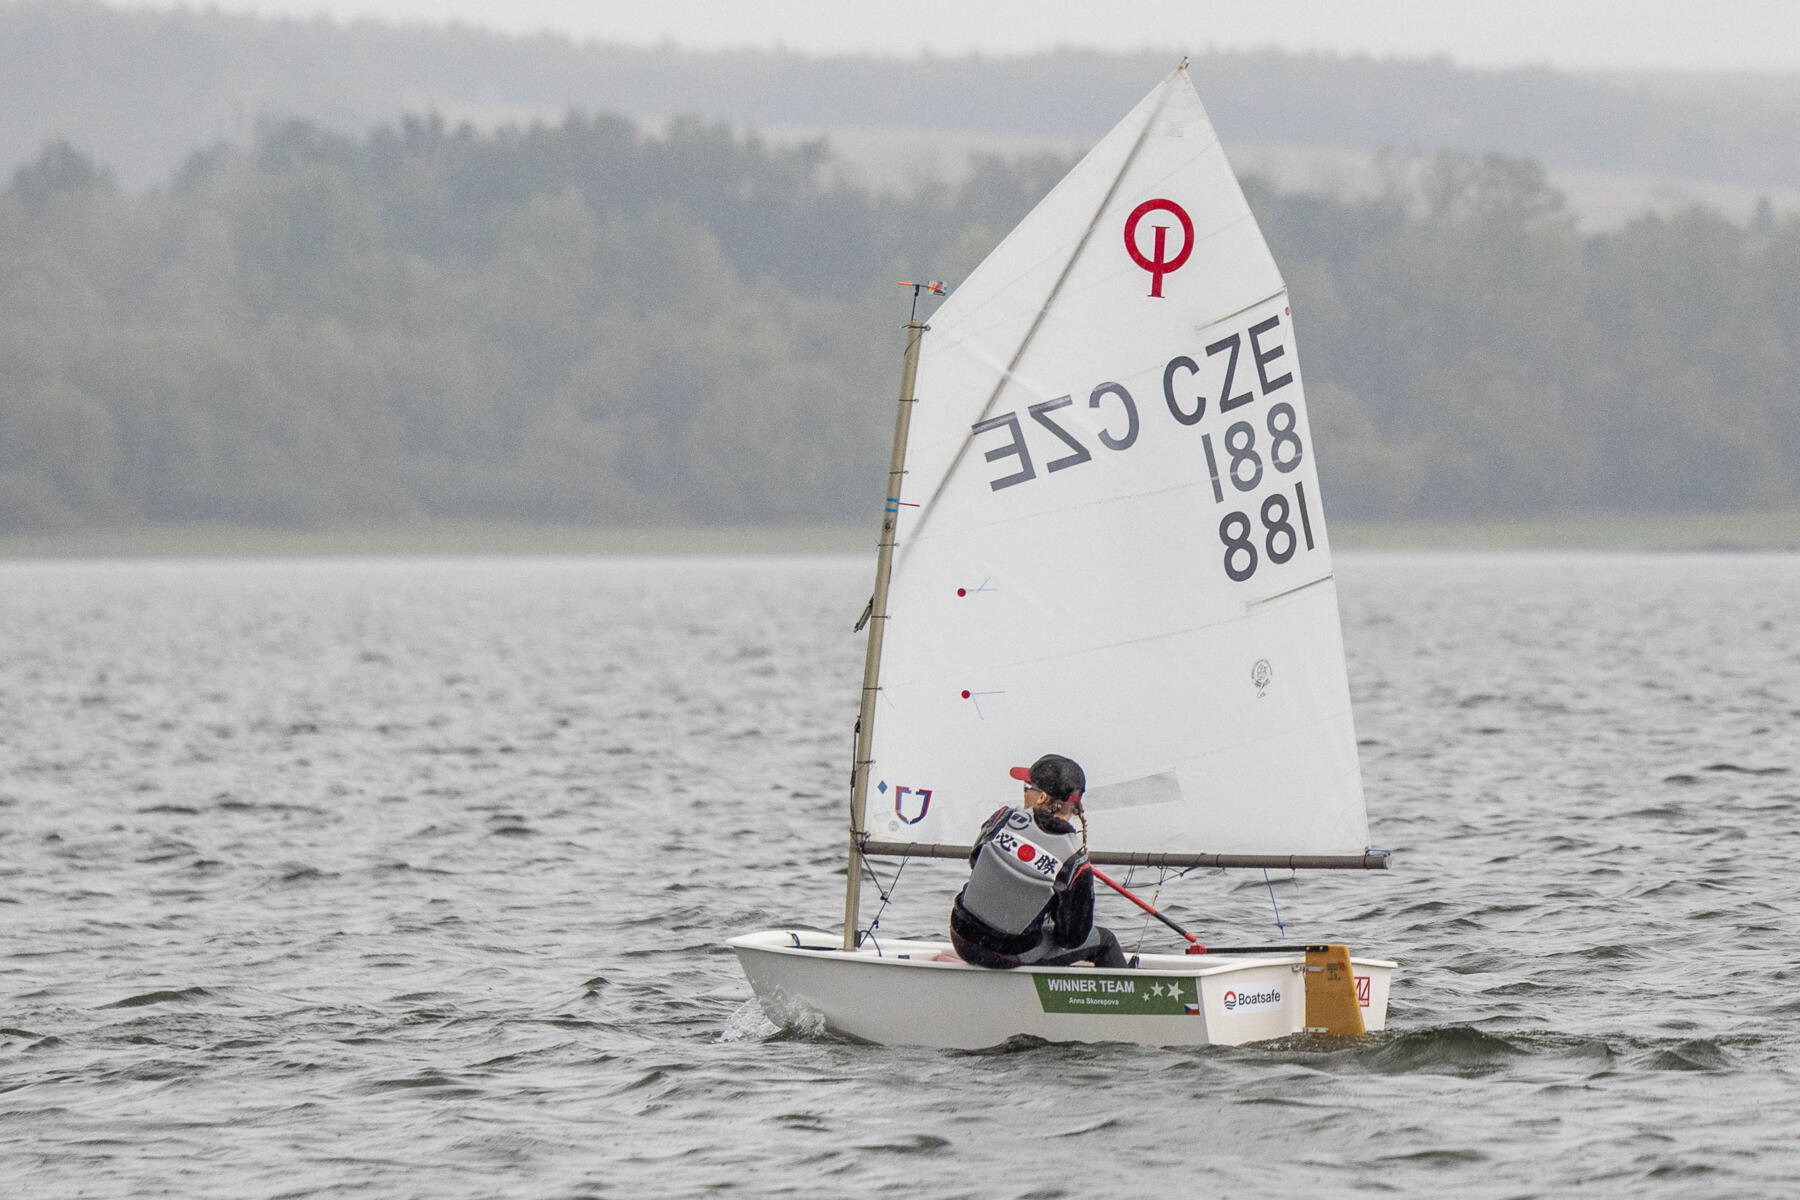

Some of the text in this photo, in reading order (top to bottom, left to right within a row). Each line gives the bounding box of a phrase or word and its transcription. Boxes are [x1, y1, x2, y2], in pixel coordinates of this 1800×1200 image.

[1163, 315, 1293, 425] CZE
[1219, 481, 1315, 582] 881
[1047, 978, 1135, 993] WINNER TEAM
[1068, 997, 1085, 1005] Anna
[1238, 989, 1281, 1006] Boatsafe
